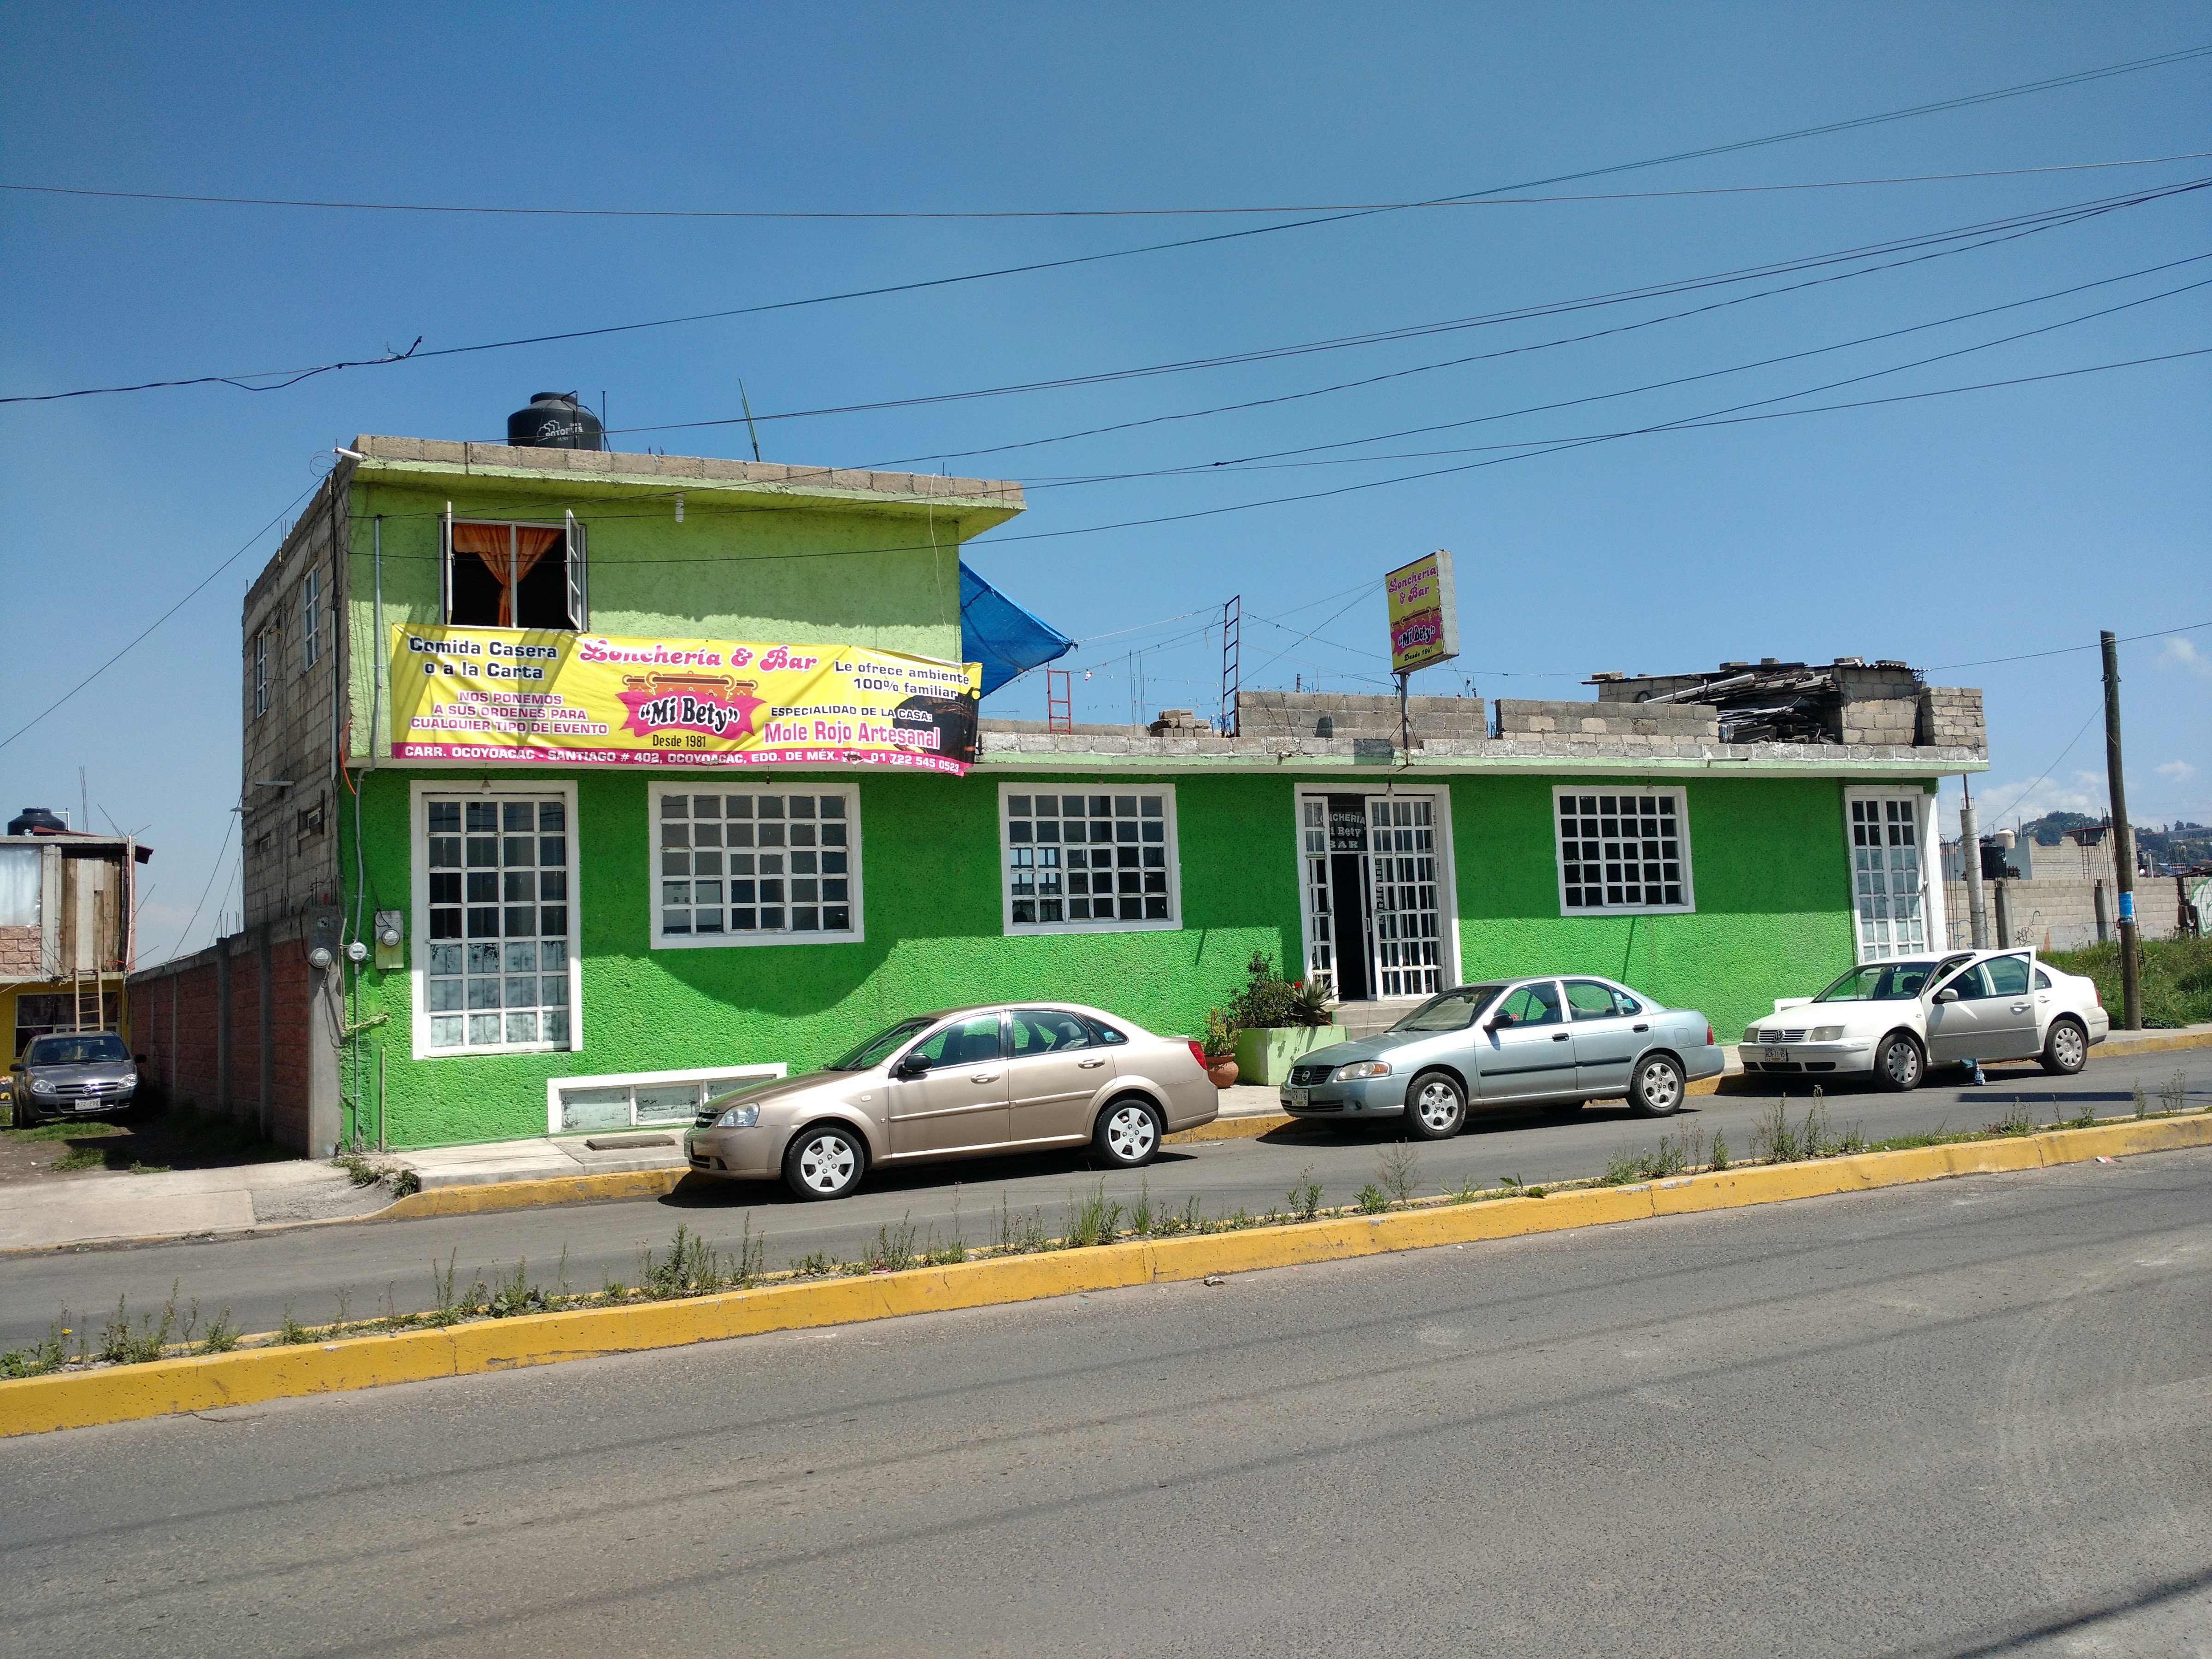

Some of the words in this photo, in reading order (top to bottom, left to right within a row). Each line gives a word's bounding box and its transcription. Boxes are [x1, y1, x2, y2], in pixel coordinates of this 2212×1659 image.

[1400, 592, 1405, 604] &
[1408, 584, 1429, 602] Bar
[409, 637, 481, 654] Comida
[489, 641, 557, 658] Casera
[580, 639, 722, 666] Lonchería
[731, 648, 753, 666] &
[760, 646, 817, 671] Bar
[1404, 651, 1420, 661] Desde
[424, 663, 435, 673] o
[443, 664, 453, 675] a
[463, 662, 478, 676] la
[487, 663, 542, 678] Carta
[835, 661, 852, 671] Le
[858, 664, 903, 676] ofrece
[909, 669, 969, 684] ambiente
[854, 678, 899, 691] 100%
[904, 682, 957, 698] familiar
[460, 692, 488, 703] NOS
[494, 694, 562, 705] PONEMOS
[434, 705, 443, 713] A
[448, 705, 476, 715] SUS
[481, 707, 546, 718] ORDENES
[551, 709, 586, 719] PARA
[771, 706, 856, 716] ESPECIALIDAD
[861, 707, 876, 716] DE
[882, 708, 895, 717] LA
[898, 710, 932, 721] CASA:
[411, 718, 491, 730] CUALQUIER
[495, 722, 526, 732] TIPO
[531, 723, 549, 733] DE
[554, 723, 607, 734] EVENTO
[765, 723, 807, 743] Mole
[815, 721, 851, 744] Rojo
[859, 723, 939, 748] Artesanal
[653, 735, 682, 747] Desde
[685, 735, 706, 747] 1981
[405, 746, 446, 757] CARR.
[452, 747, 535, 759] OCOYOACAC
[547, 750, 616, 762] SANTIAGO
[620, 753, 630, 762] #
[634, 752, 663, 764] 402,
[668, 753, 747, 764] OCOYOACAC,
[752, 753, 781, 762] EDO.
[786, 752, 803, 761] DE
[807, 748, 838, 761] MÉX.
[871, 753, 886, 762] 01
[890, 753, 912, 764] 722
[916, 756, 935, 768] 545
[939, 760, 959, 773] 0523
